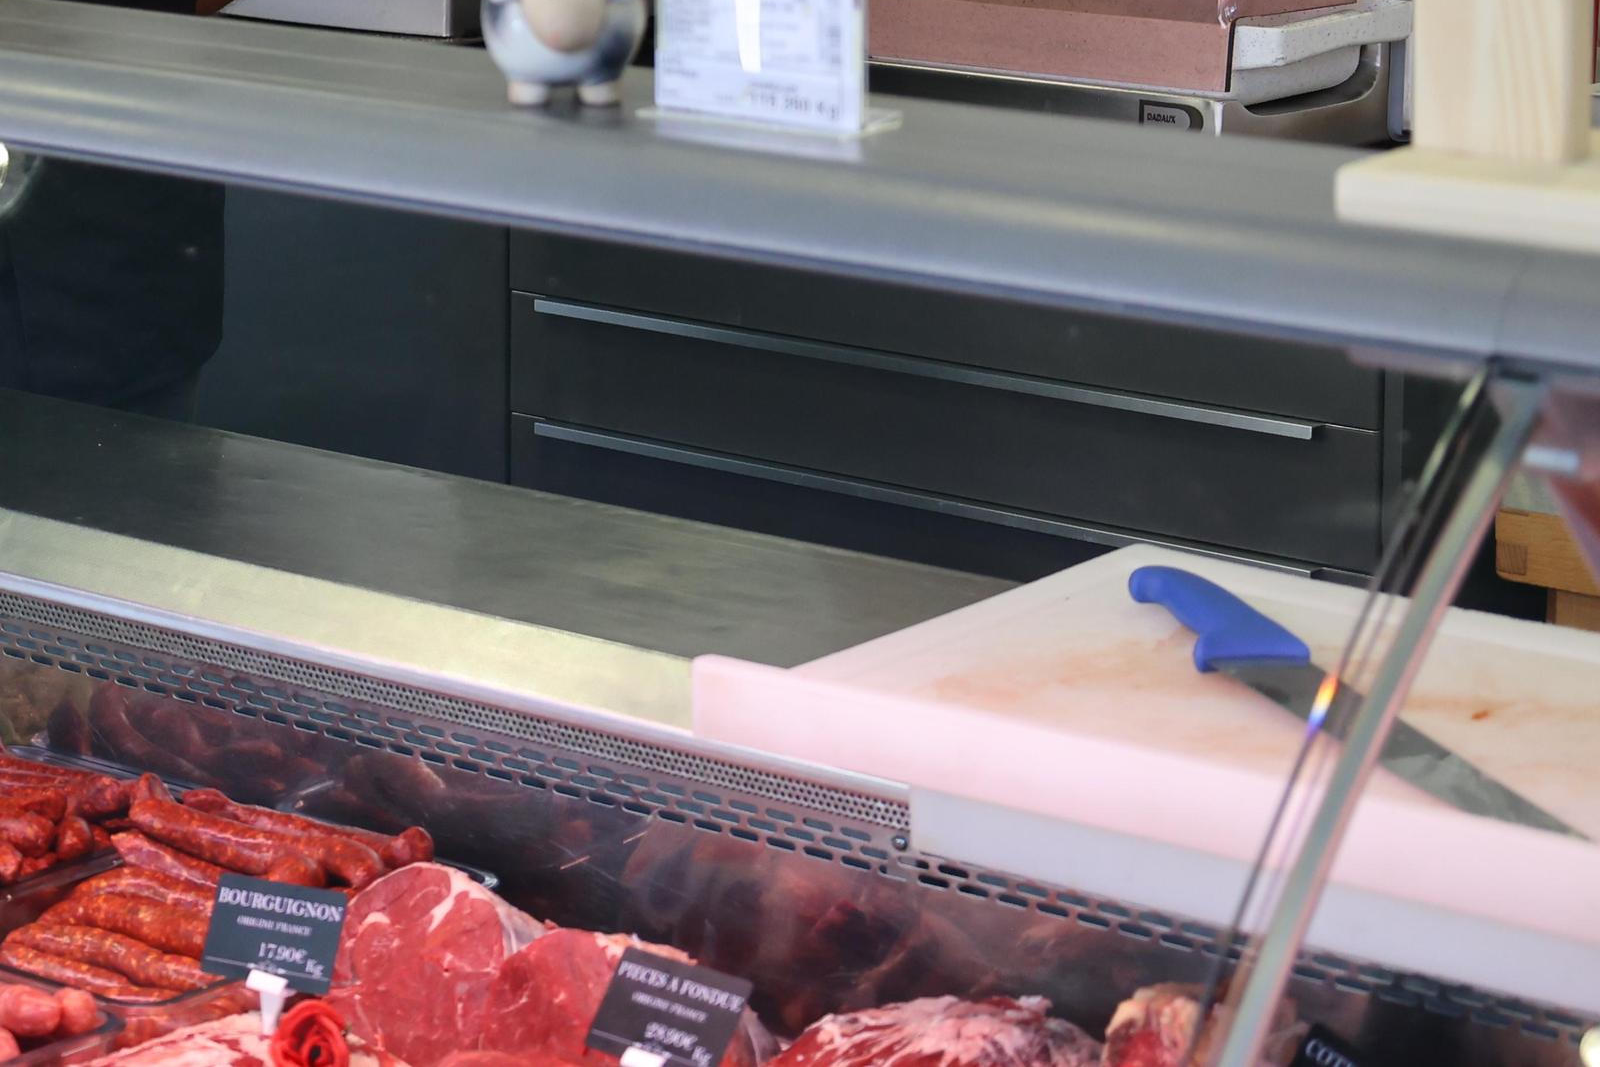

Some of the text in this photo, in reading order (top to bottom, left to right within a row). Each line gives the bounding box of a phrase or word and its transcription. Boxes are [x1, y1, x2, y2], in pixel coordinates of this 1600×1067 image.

[218, 886, 344, 922] BOURGUIGNON
[305, 958, 325, 979] Kg
[679, 979, 745, 1013] FONDUE
